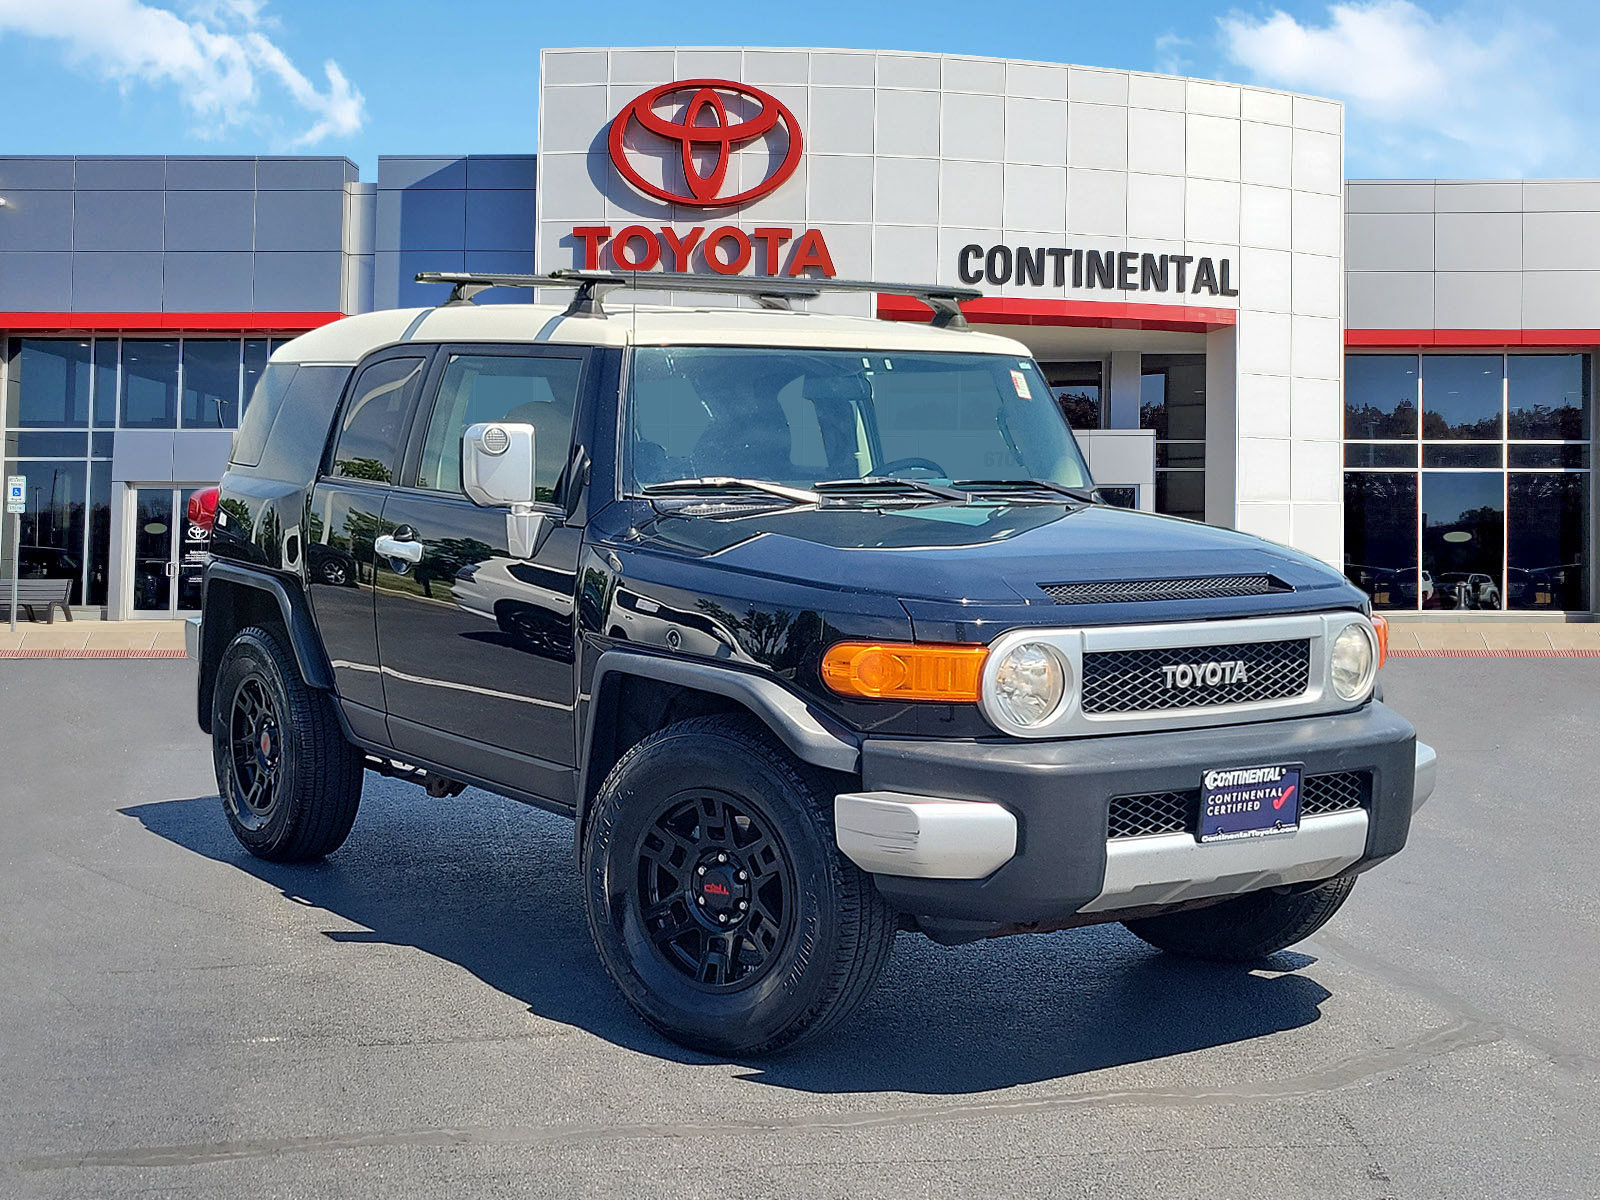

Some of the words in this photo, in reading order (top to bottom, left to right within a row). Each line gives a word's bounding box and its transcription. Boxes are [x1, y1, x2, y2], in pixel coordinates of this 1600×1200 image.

[572, 225, 837, 276] TOYOTA
[958, 244, 1239, 296] CONTINENTAL
[1162, 661, 1248, 688] TOYOTA
[1204, 767, 1282, 789] CONTINENTAL
[1207, 787, 1283, 805] CONTINENTAL
[1207, 800, 1261, 816] CERTIFIED
